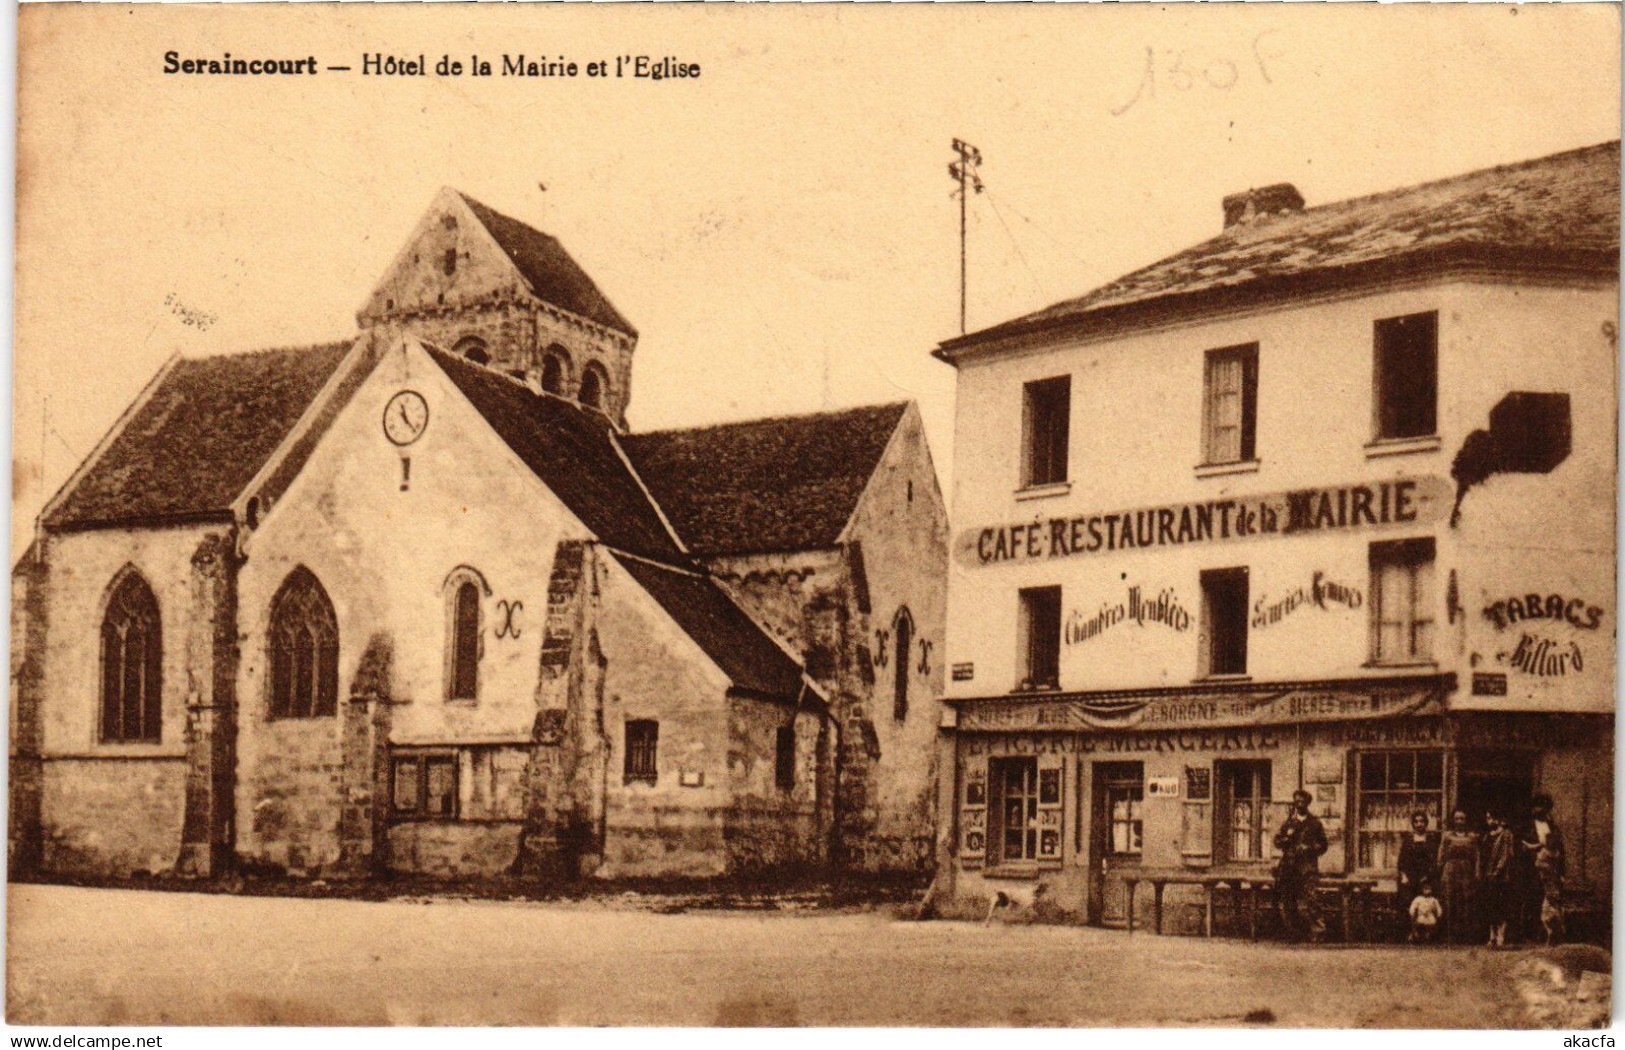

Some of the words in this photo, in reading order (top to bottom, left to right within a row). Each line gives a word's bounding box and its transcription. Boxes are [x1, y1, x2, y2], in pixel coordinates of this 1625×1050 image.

[1049, 500, 1235, 557] RESTAURANT
[1235, 503, 1256, 537] de
[1260, 502, 1278, 534] la
[1282, 481, 1417, 535] MAIRIE
[1482, 593, 1604, 632] TABACS
